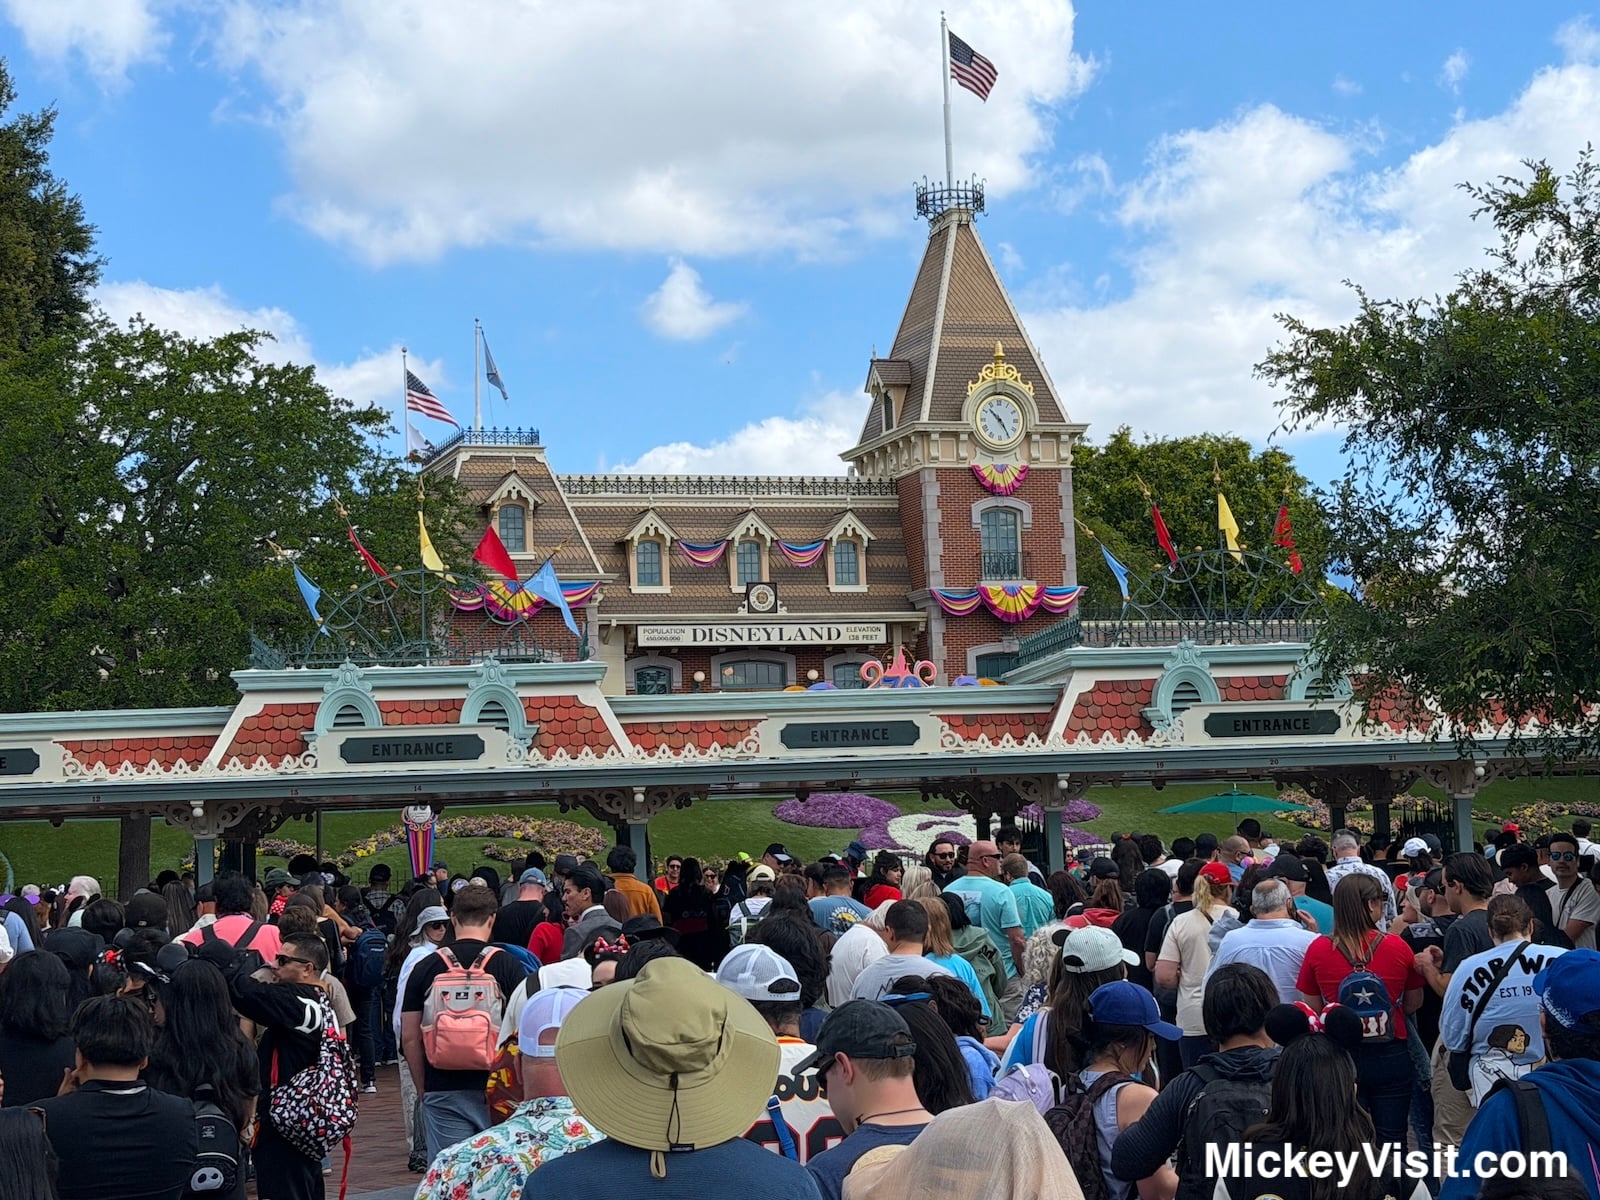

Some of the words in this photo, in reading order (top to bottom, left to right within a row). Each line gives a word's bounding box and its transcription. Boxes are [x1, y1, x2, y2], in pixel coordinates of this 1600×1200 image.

[692, 627, 841, 642] DISNEYLAND
[1233, 719, 1311, 732] ENTRANCE
[811, 728, 889, 742] ENTRANCE
[372, 742, 453, 756] ENTRANCE
[1461, 957, 1504, 1014] STAR
[1500, 985, 1520, 998] EST.
